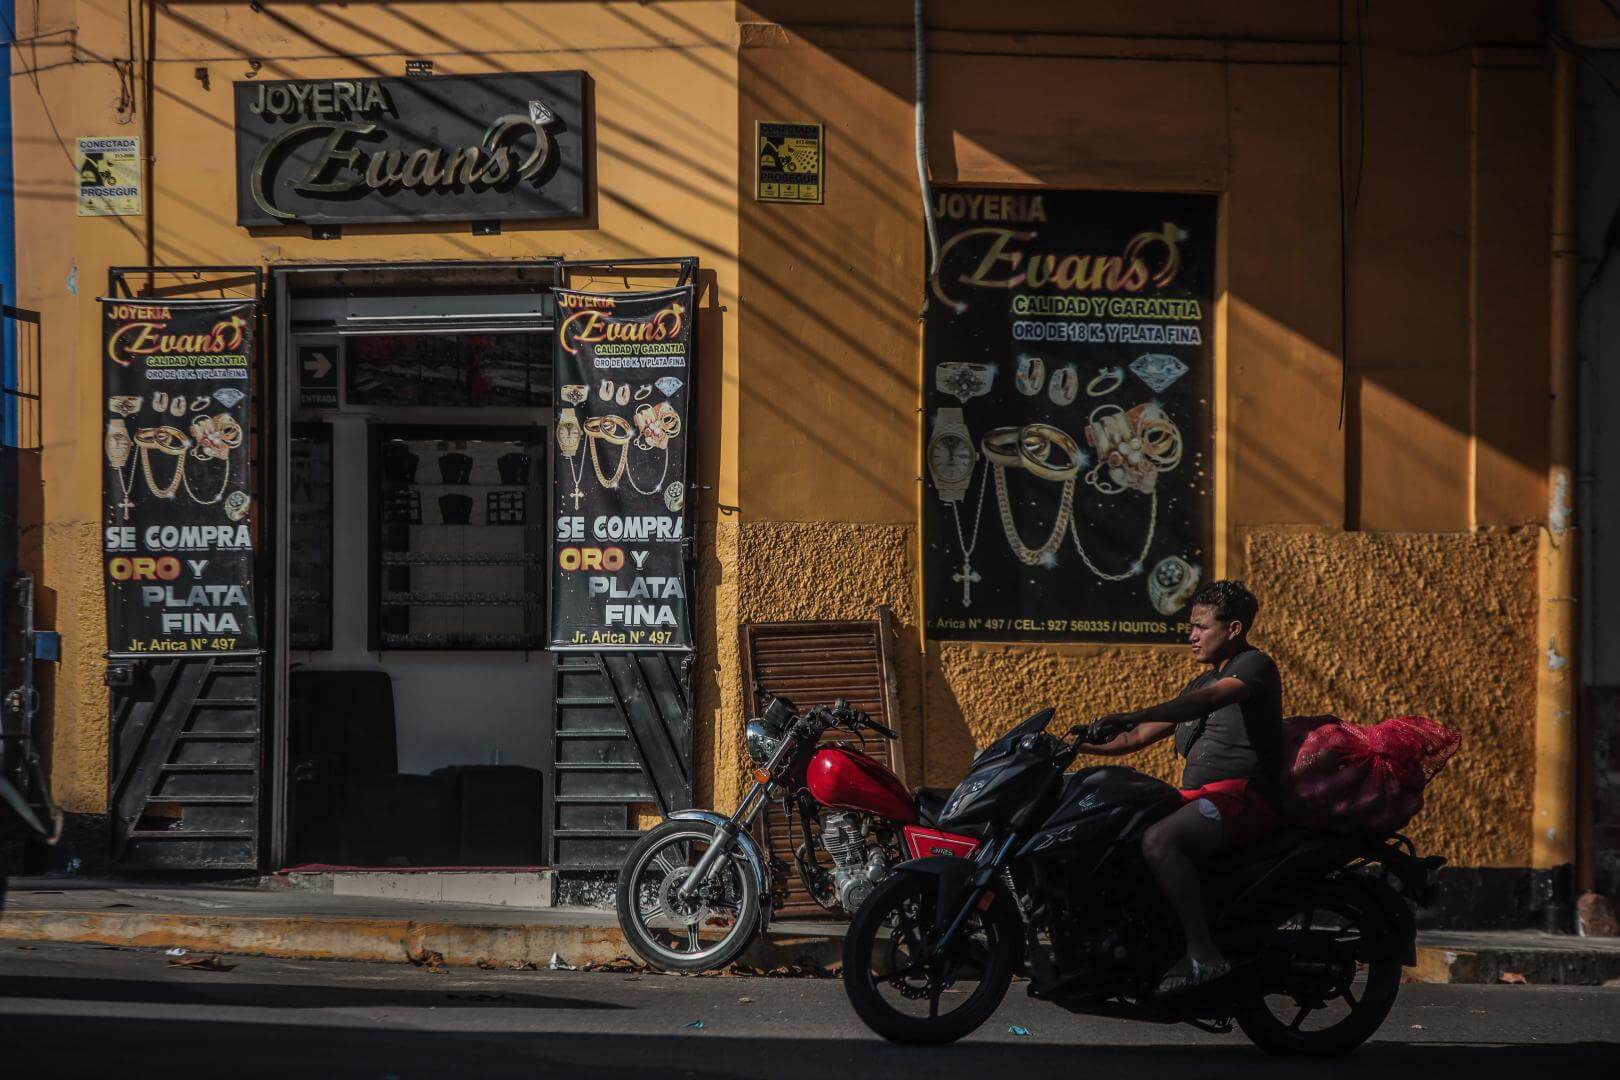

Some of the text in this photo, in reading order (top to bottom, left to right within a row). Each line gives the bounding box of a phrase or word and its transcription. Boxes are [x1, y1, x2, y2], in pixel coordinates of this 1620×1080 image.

[249, 82, 389, 115] JOYERIA
[80, 140, 136, 148] CONECTADA
[251, 122, 511, 219] Evans
[81, 188, 137, 197] PROSEGUR
[935, 194, 1047, 222] JOYERIA
[931, 227, 1150, 315] Evans
[559, 293, 615, 308] JOYERIA
[1012, 296, 1202, 320] CALIDAD Y GARANTIA
[108, 306, 173, 320] JOYERIA
[560, 310, 667, 354] Evans
[1012, 322, 1202, 345] ORO DE 18 K. Y PLATA FINA
[108, 322, 226, 366] Evans
[595, 343, 685, 355] CALIDAD Y GARANTIA
[146, 355, 247, 367] CALIDAD Y GARANTIA
[594, 358, 611, 368] ORO
[612, 358, 622, 368] DE
[640, 358, 647, 368] Y
[647, 357, 670, 367] PLATA
[670, 357, 685, 367] FINA
[105, 525, 253, 551] SE COMPRA
[556, 516, 585, 542] SE
[109, 556, 209, 581] ORO Y
[559, 547, 649, 572] ORO Y
[142, 585, 248, 607] PLATA
[588, 577, 684, 599] PLATA
[161, 613, 242, 634] FINA
[605, 604, 678, 627] FINA
[937, 618, 966, 630] Arica
[985, 619, 1005, 630] 497
[1014, 620, 1045, 632] CEL.:
[1047, 620, 1068, 632] 927
[1071, 620, 1110, 632] 560335
[1118, 621, 1167, 634] IQUITOS
[128, 639, 147, 652] Jr.
[150, 638, 188, 651] Arica
[211, 638, 237, 650] 497
[572, 631, 588, 645] Jr.
[591, 630, 626, 644] Arica
[649, 631, 672, 644] 497
